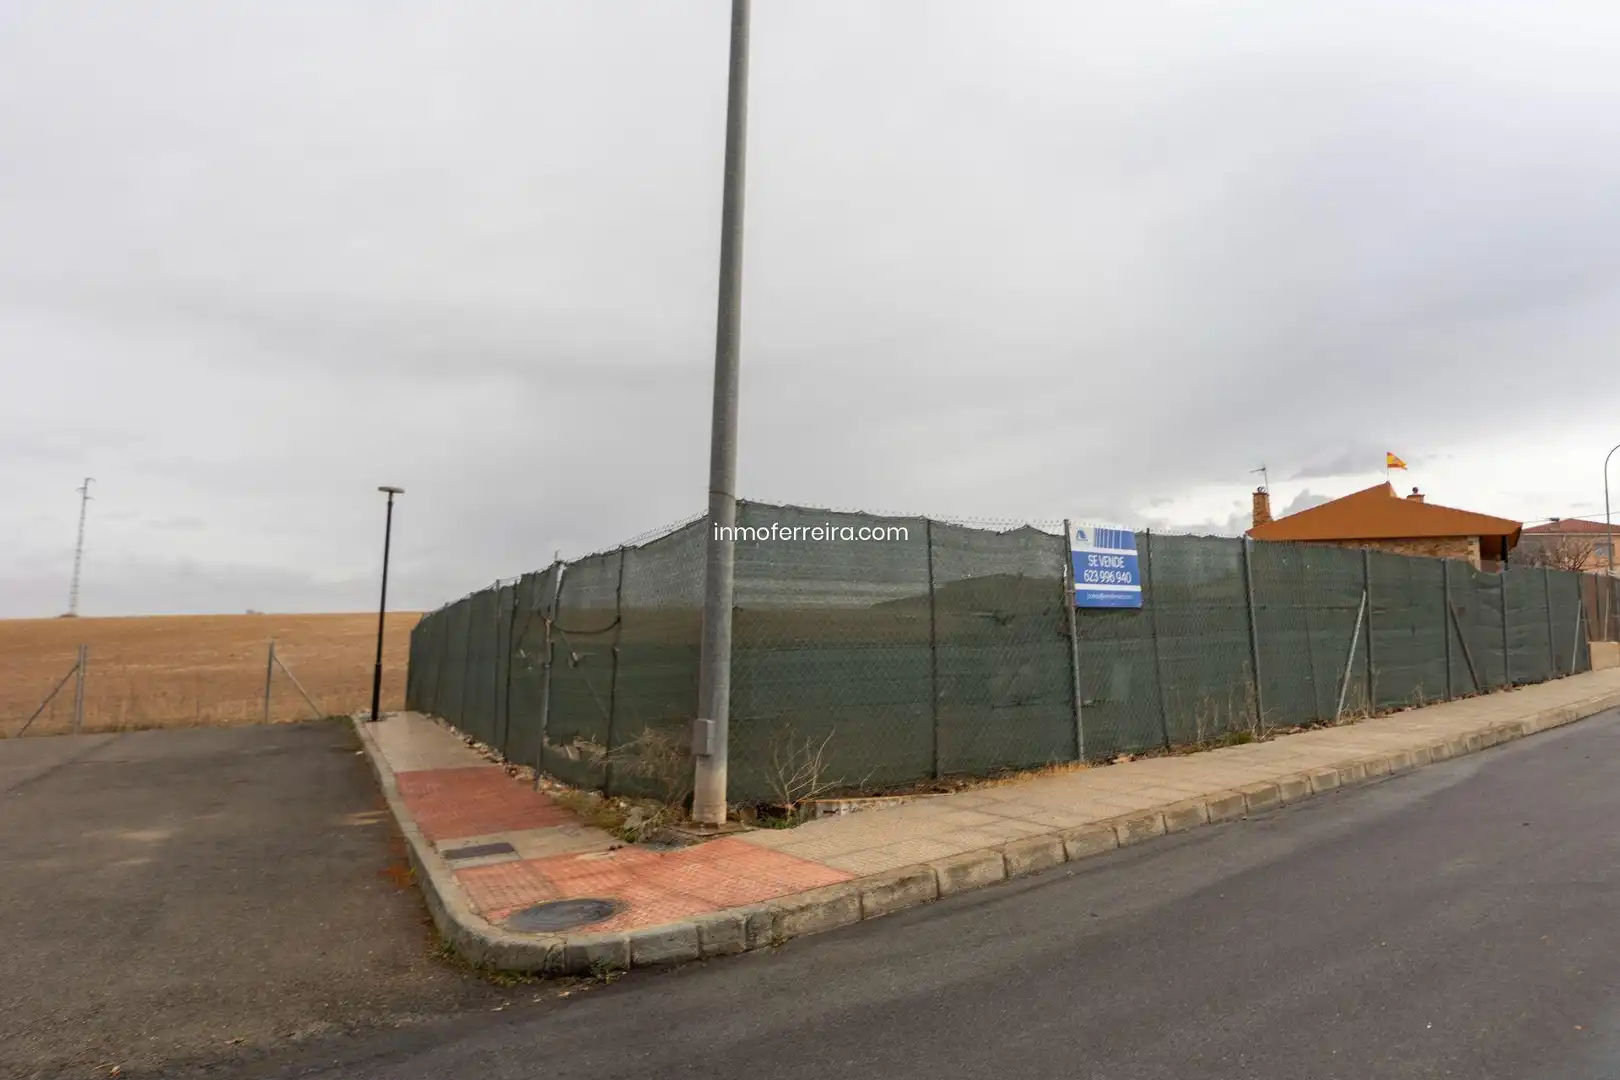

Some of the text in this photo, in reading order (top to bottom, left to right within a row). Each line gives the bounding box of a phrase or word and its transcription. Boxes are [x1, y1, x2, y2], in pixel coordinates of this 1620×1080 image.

[1087, 554, 1125, 568] SE VENDE
[1083, 569, 1132, 584] 623 996 940
